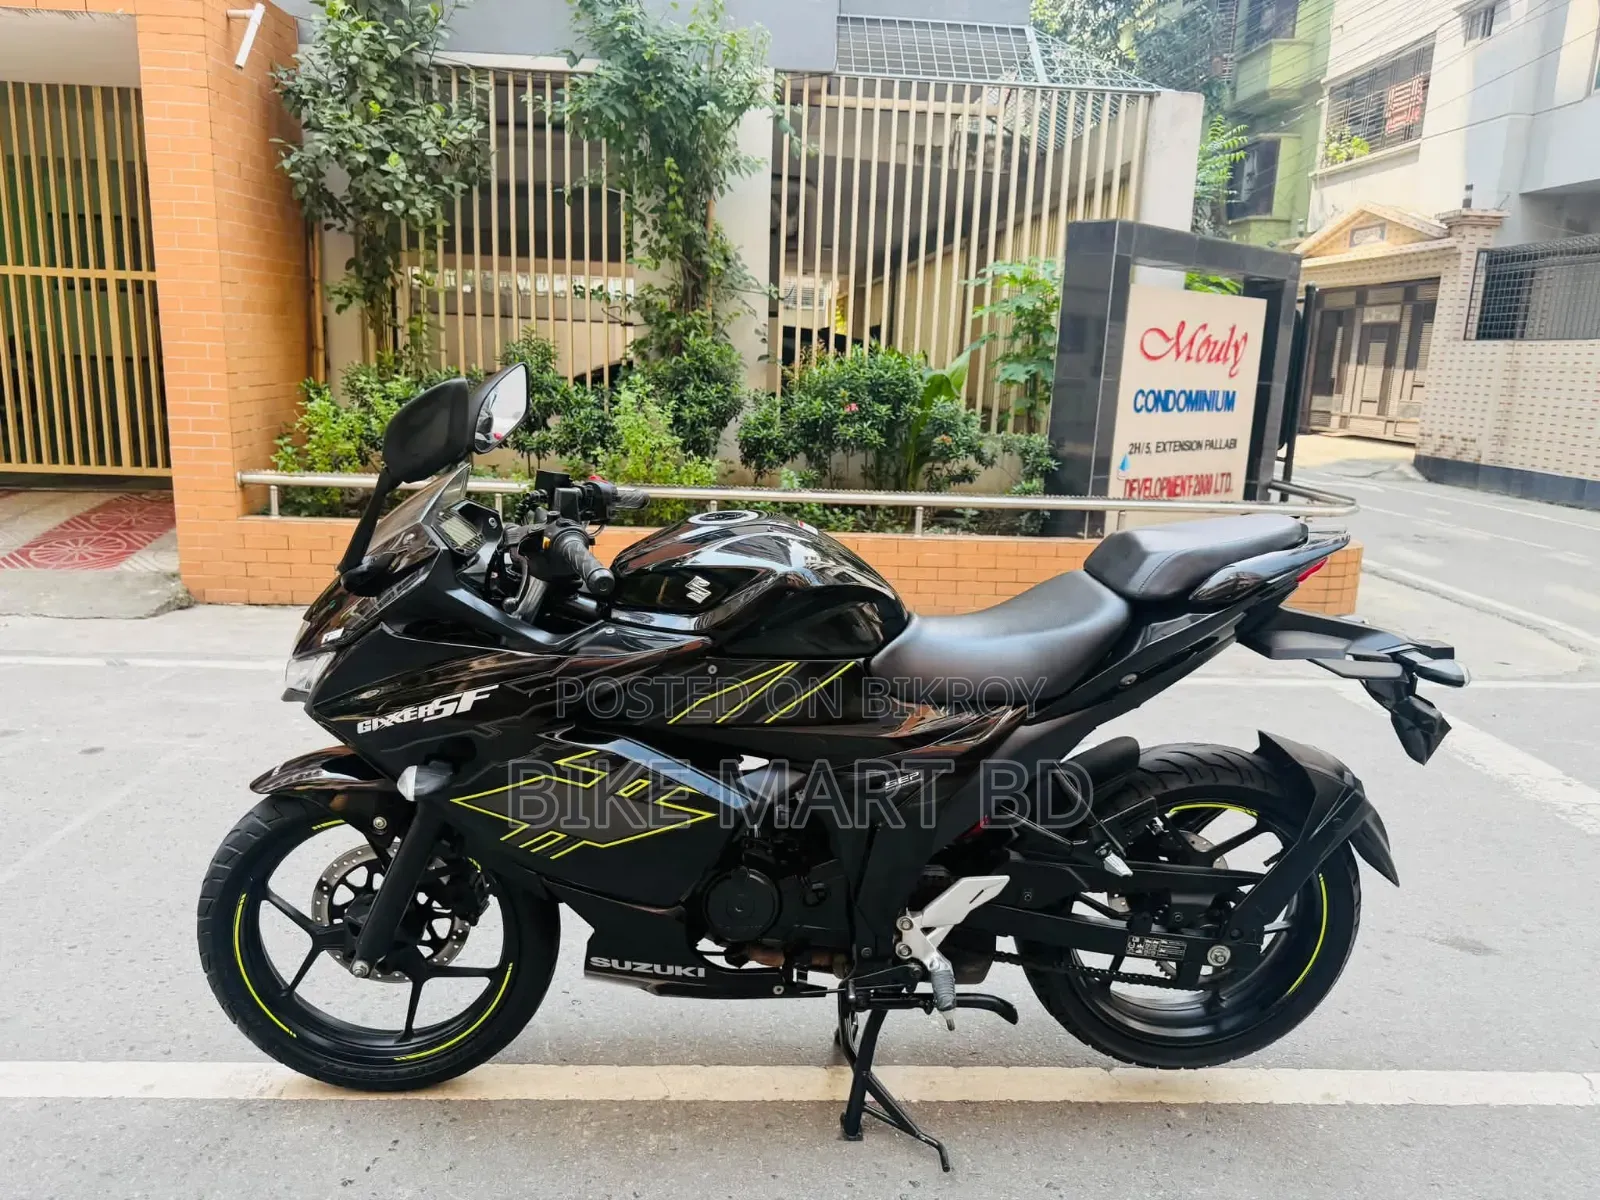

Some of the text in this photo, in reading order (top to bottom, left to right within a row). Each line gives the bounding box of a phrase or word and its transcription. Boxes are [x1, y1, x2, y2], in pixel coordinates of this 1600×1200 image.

[1139, 320, 1248, 378] Mouly
[1133, 389, 1237, 414] CONDOMINIUM
[1155, 440, 1204, 454] EXTENSION
[1204, 438, 1238, 451] PALLABI
[588, 956, 706, 978] SUZUKI
